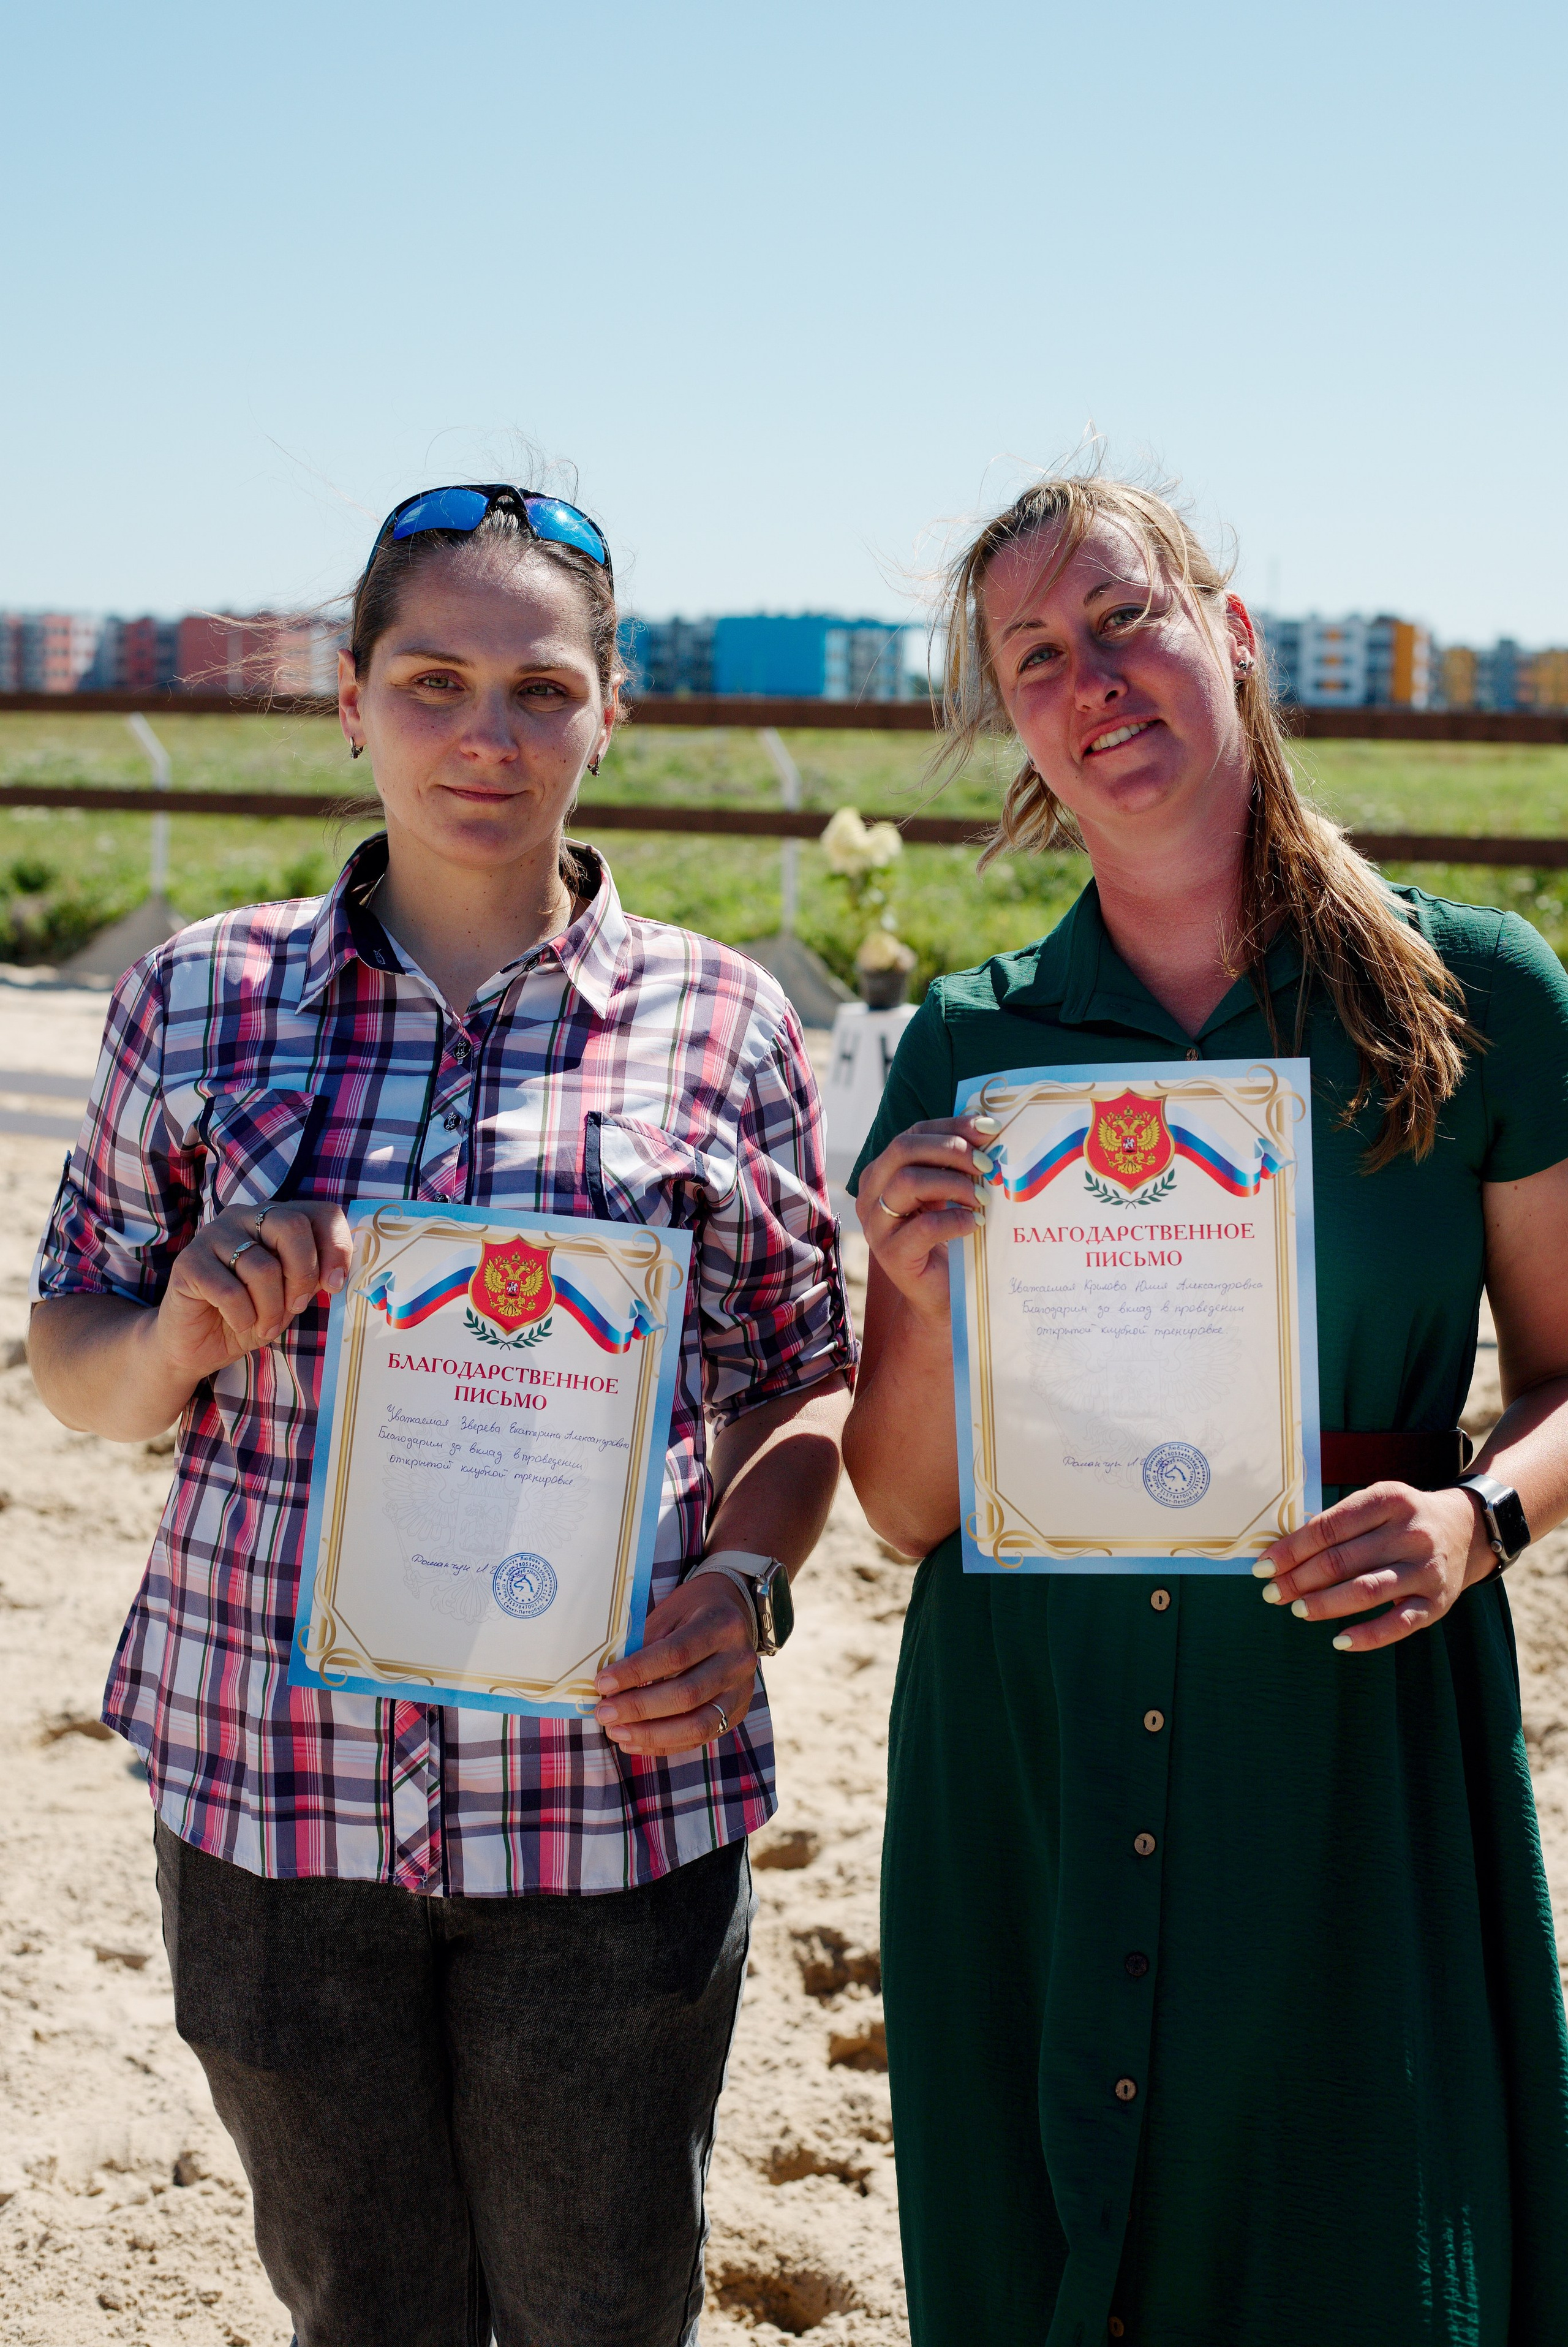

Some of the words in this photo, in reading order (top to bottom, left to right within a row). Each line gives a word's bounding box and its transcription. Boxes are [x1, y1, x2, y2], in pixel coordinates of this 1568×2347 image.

[1013, 1223, 1255, 1245] БЛАГОДАРСТВЕННОЕ
[1086, 1250, 1182, 1267] ПИСЬМО
[1022, 1300, 1087, 1320] Благодарим
[1097, 1304, 1110, 1318] за
[1118, 1301, 1152, 1320] вклад
[1161, 1300, 1170, 1312] в
[1174, 1301, 1244, 1317] проведении
[1101, 1324, 1149, 1339] клубной
[387, 1353, 619, 1394] БЛАГОДАРСТВЕННОЕ
[454, 1385, 547, 1410] ПИСЬМО
[386, 1404, 449, 1426] Уважаемая
[461, 1416, 500, 1434] Зверева
[510, 1421, 561, 1442] Екатерина
[469, 1442, 503, 1465] вклад
[461, 1465, 508, 1479] клубной
[1156, 1491, 1199, 1504] Санкт-Петербург
[503, 1601, 545, 1614] Санкт-Петербург
